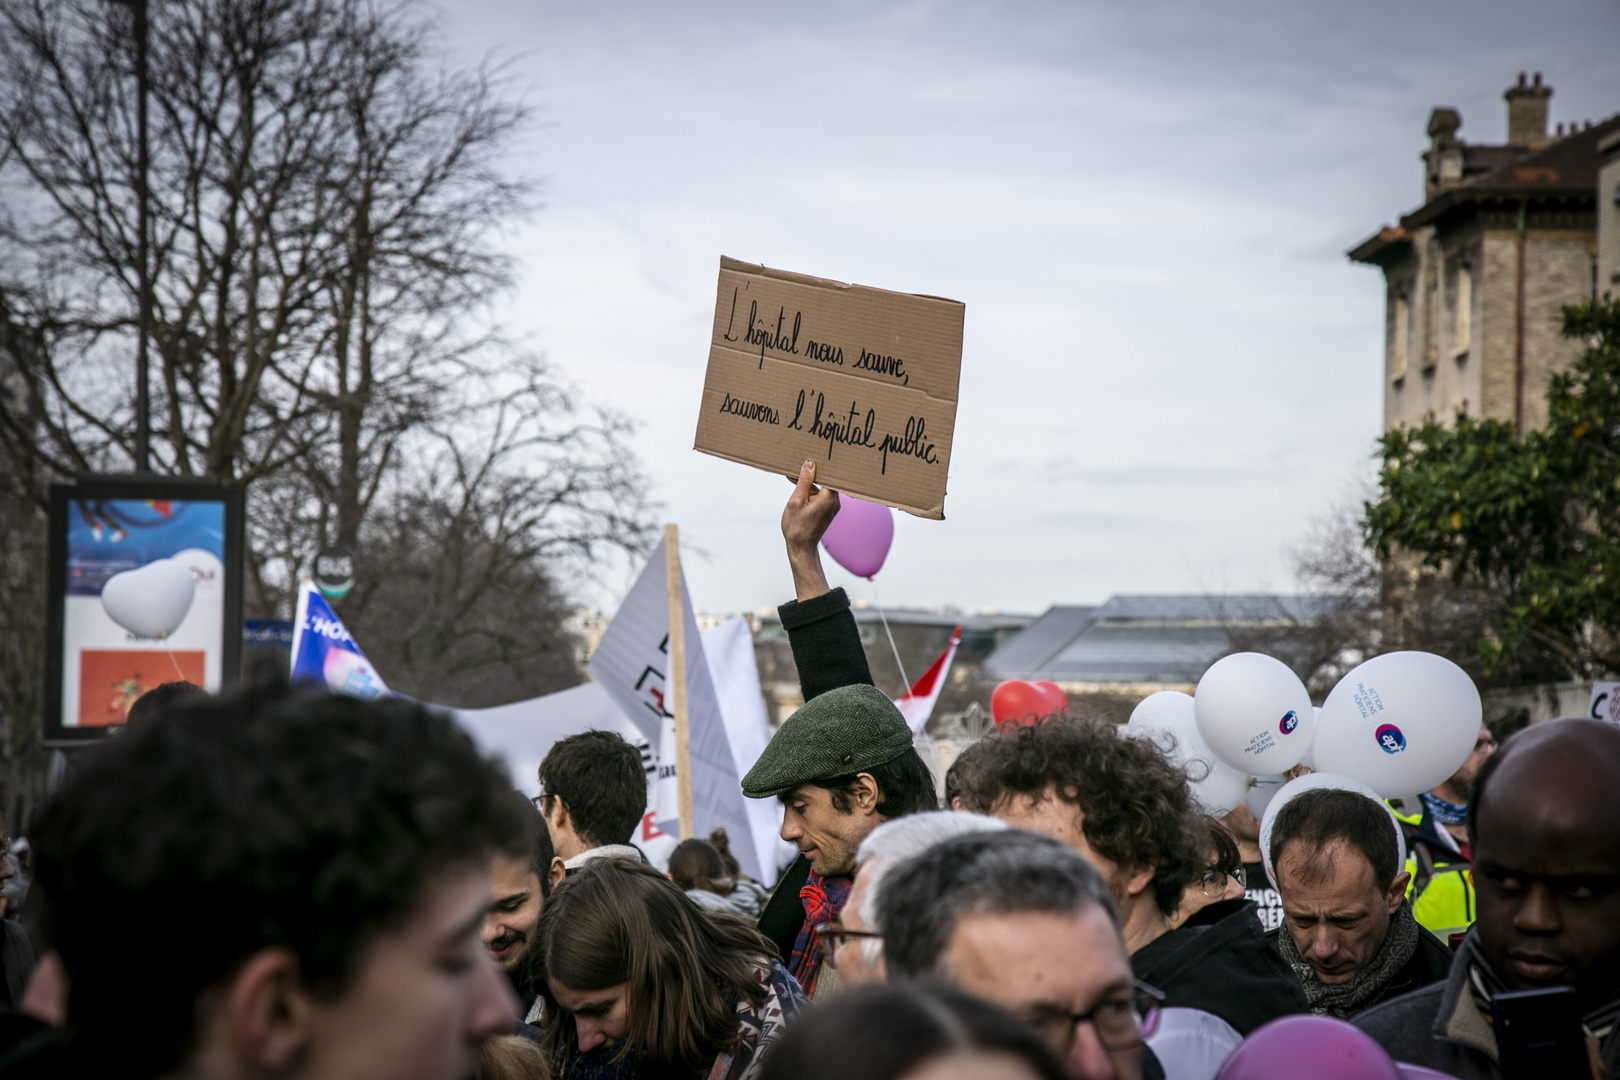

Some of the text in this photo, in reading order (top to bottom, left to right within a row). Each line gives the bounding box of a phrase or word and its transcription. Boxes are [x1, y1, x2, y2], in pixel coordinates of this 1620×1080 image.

[724, 280, 909, 385] L'hôpital nous sauve,
[719, 388, 940, 475] sauvons l'hôpital public.
[317, 555, 353, 577] BUS
[1352, 693, 1370, 720] HÔPITAL
[1357, 682, 1378, 715] PRATICIENS
[1368, 688, 1386, 711] ACTION
[1243, 734, 1273, 754] PRATICIENS
[1249, 730, 1270, 745] ACTION
[1254, 740, 1276, 755] HÔPITAL
